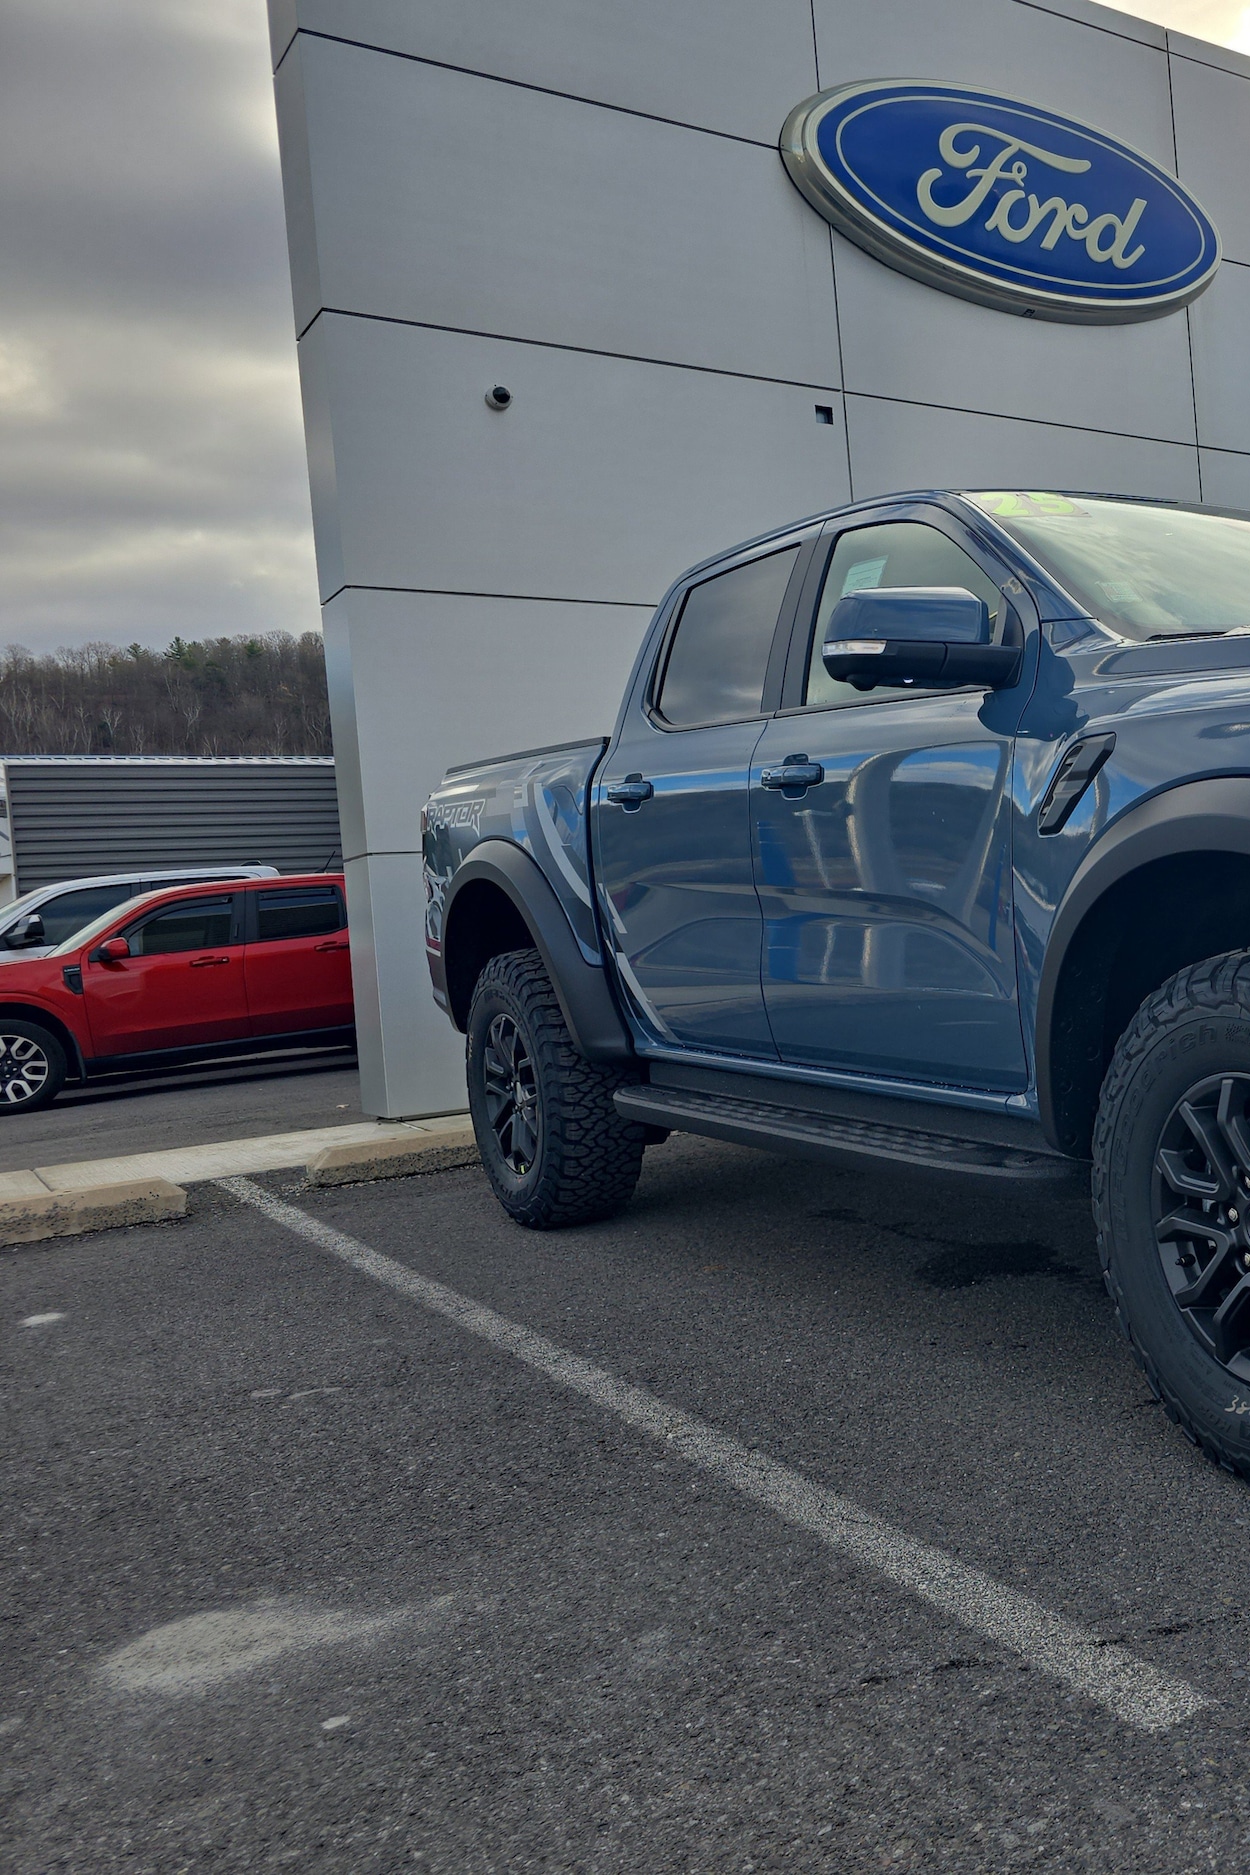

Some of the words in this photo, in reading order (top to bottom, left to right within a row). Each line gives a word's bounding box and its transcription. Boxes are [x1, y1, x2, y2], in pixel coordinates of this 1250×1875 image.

[917, 123, 1146, 269] Ford
[981, 492, 1074, 516] 25
[427, 799, 486, 840] RAPTOR
